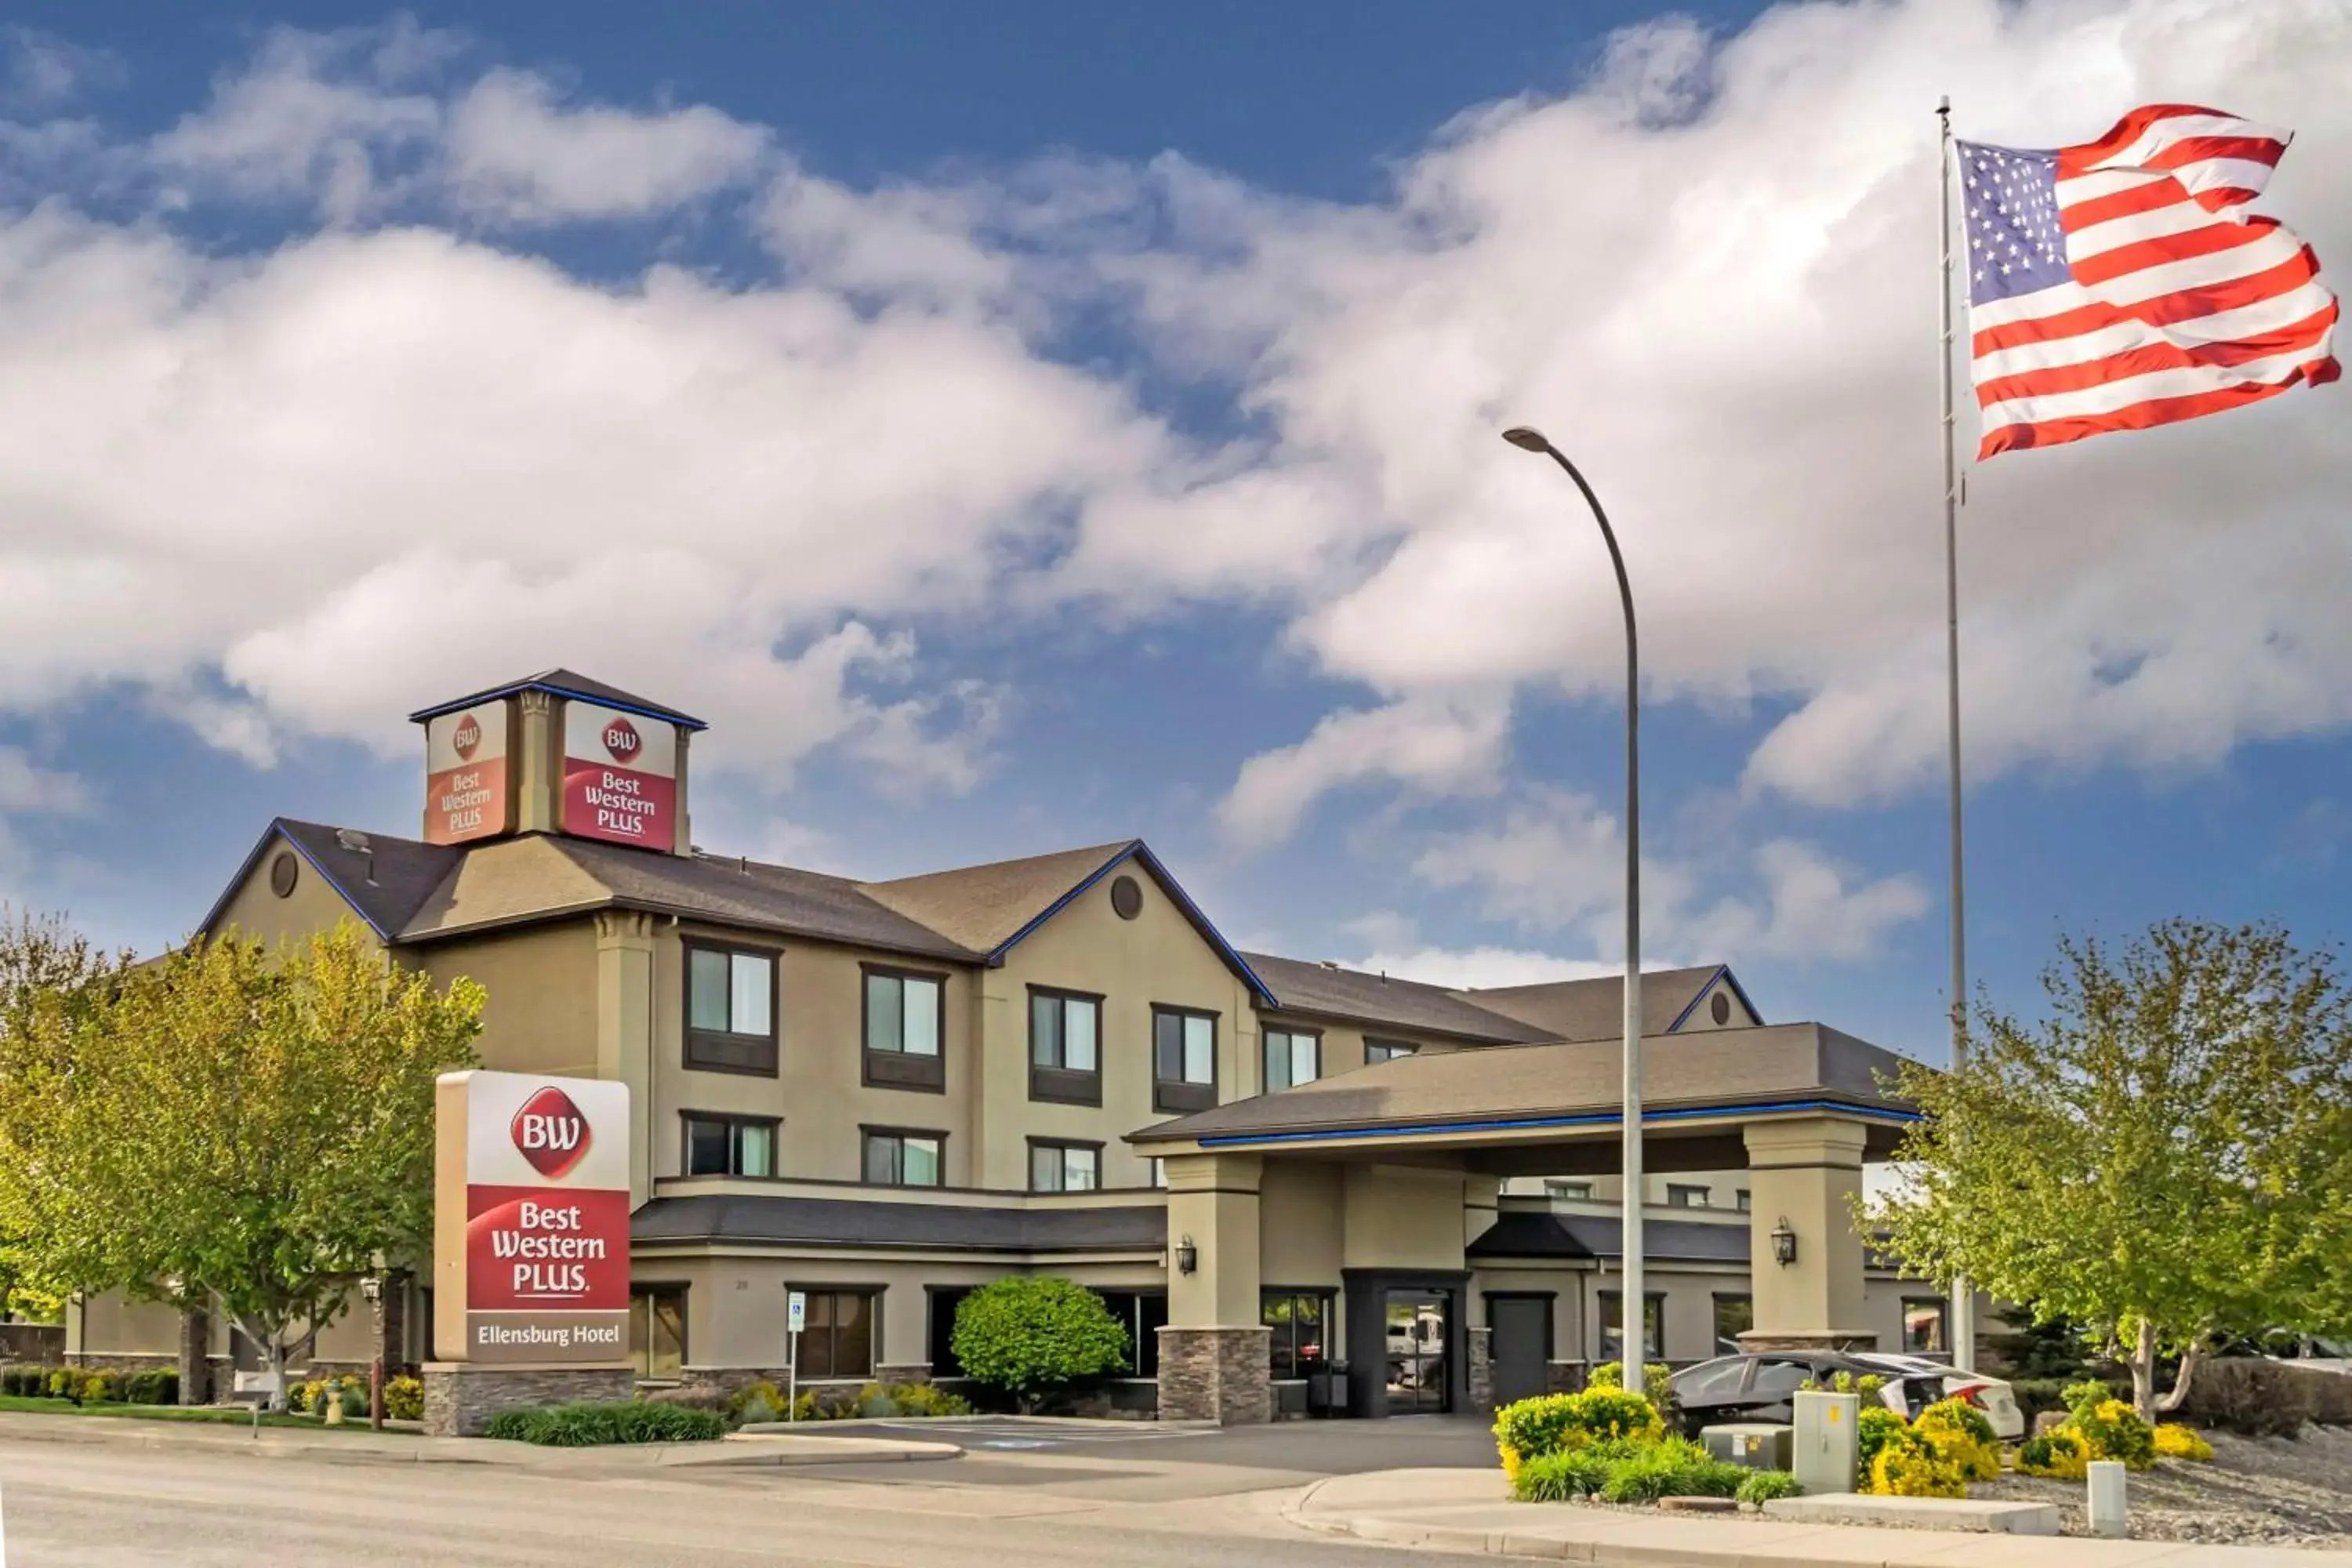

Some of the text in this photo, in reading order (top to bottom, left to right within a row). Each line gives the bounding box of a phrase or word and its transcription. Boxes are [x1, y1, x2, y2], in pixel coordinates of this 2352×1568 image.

[456, 727, 477, 748] BW
[607, 730, 636, 751] BW
[453, 772, 479, 791] Best
[602, 771, 641, 795] Best
[441, 789, 491, 812] Western
[585, 786, 655, 815] Western
[522, 1114, 579, 1150] BW
[520, 1202, 582, 1230] Best
[492, 1230, 606, 1259] Western
[477, 1324, 620, 1346] Ellensburg Hotel
